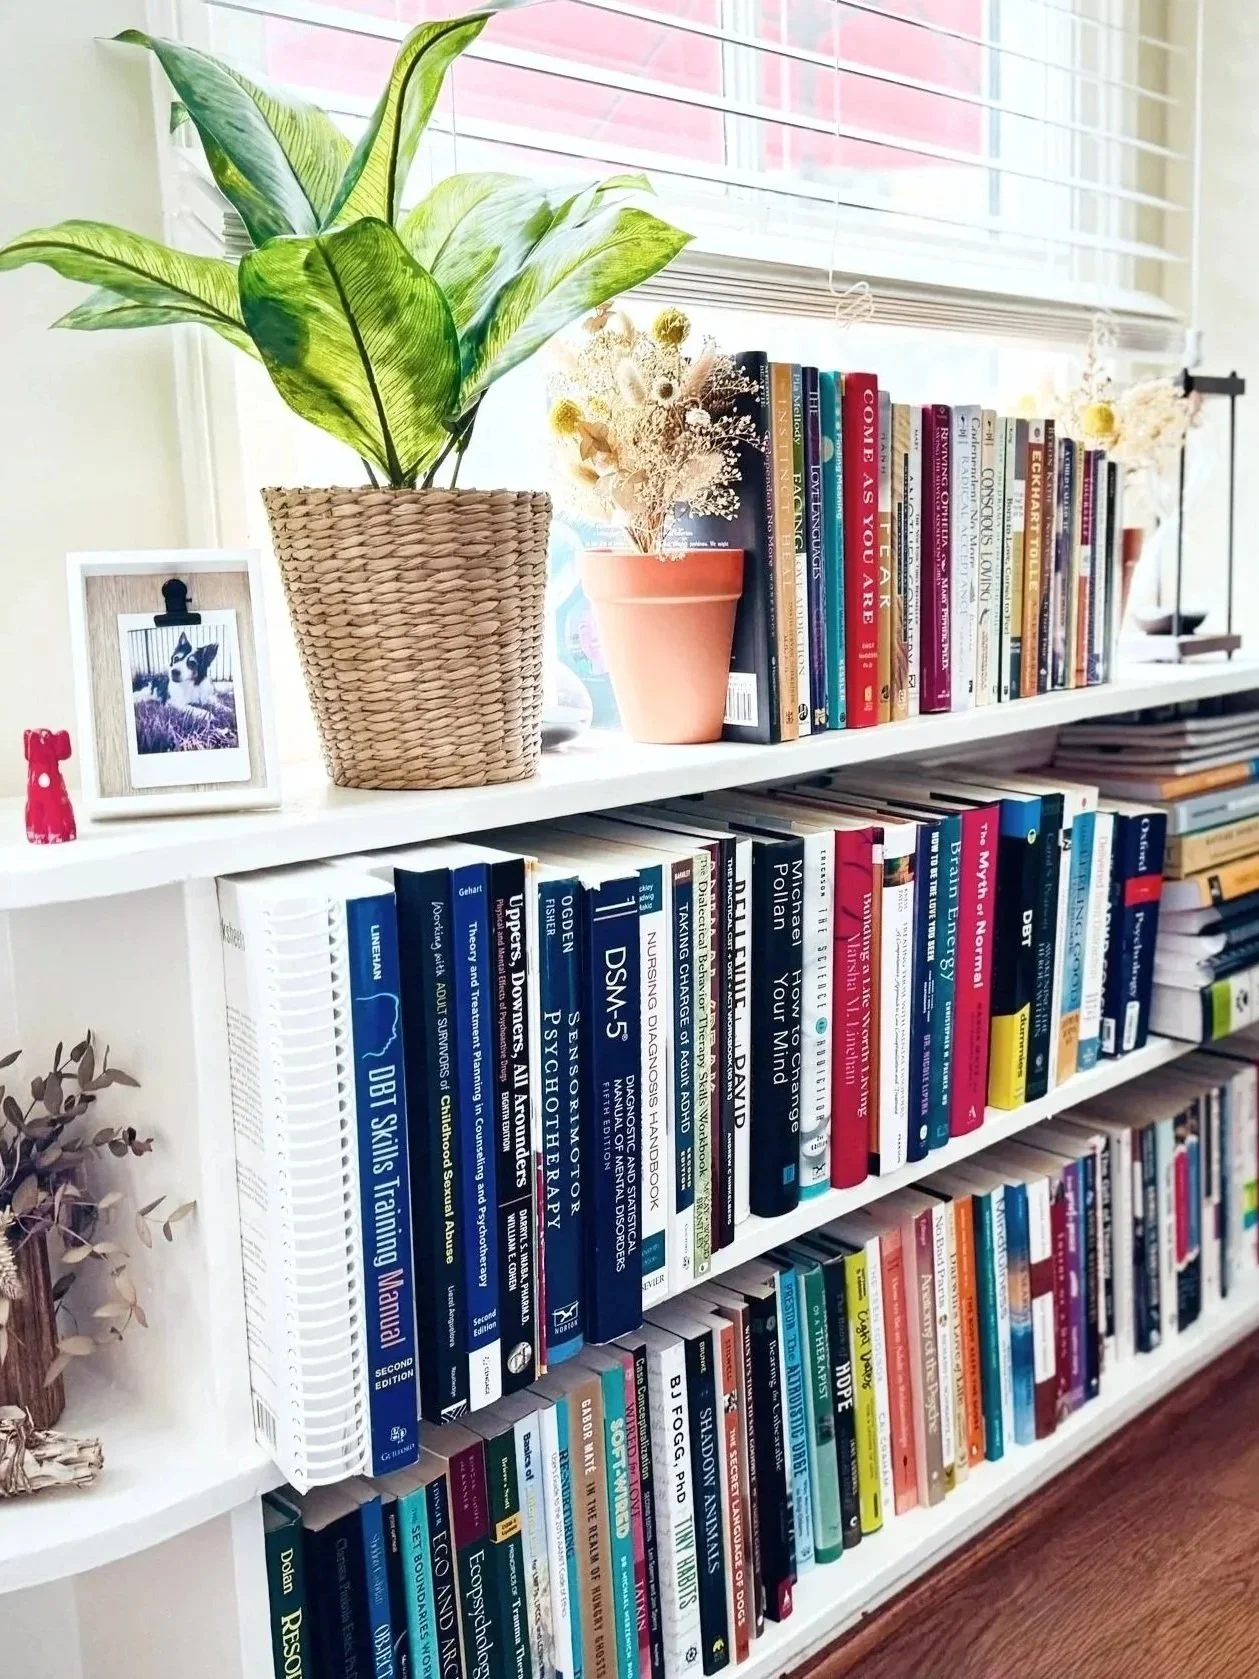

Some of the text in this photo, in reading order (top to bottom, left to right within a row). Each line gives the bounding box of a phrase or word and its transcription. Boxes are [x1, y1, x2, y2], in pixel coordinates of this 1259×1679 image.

[777, 399, 791, 514] INSTINCT
[809, 391, 822, 580] THE LOVE LANGUAGES
[941, 428, 949, 547] REVIVING OPHELIA
[793, 472, 803, 551] FACING
[863, 389, 874, 624] COME AS YOU ARE
[980, 468, 994, 601] CONSCIOUS LOVING
[1029, 451, 1042, 592] ECKHART TOLLE
[781, 533, 792, 592] HEAL
[879, 523, 892, 609] FEAR
[796, 598, 806, 676] ADDICTION
[975, 850, 990, 899] Myth
[979, 822, 988, 846] The
[1136, 817, 1151, 873] Oxford
[459, 887, 483, 897] Gehart
[545, 899, 556, 937] FISHER
[561, 895, 575, 954] OGDEN
[773, 862, 790, 931] Pollan
[791, 859, 803, 947] Michael
[939, 840, 962, 982] Brain Energy
[976, 903, 984, 916] of
[1021, 910, 1033, 948] DBT
[370, 925, 382, 980] LINEHAN
[973, 920, 987, 989] Normal
[1128, 911, 1145, 999] Psychology
[505, 893, 531, 1188] Uppers, Downers, All Arounders
[678, 902, 692, 1134] TAKING CHARGE of Adult ADHD
[695, 859, 710, 1178] The Dialectical Behavior Therapy Skills Workbook
[773, 973, 789, 1085] Your Mind
[857, 892, 872, 1118] Building a Life Worth Living
[1017, 1012, 1029, 1079] dummies
[431, 901, 456, 1265] Working with ADULT SURVIVORS of Childhood Sexual Abuse
[646, 932, 660, 1212] NURSING DIAGNOSIS HANDBOOK
[734, 1055, 747, 1130] DAVID
[788, 969, 802, 1134] How to Change
[466, 922, 490, 1288] Theory and Treatment Planning in Counseling and Psychotherapy
[502, 1092, 511, 1153] EIGHTH EDITION
[543, 1009, 562, 1230] PSYCHOTHERAPY
[567, 1011, 581, 1217] SENSORIMOTOR
[368, 1064, 406, 1350] DBT Skills Training Manual
[613, 1079, 626, 1273] MANUAL OF MENTAL DISORDERS
[625, 1075, 637, 1256] DIAGNOSTIC AND STATISTICAL
[934, 1216, 948, 1308] No Bad Parts
[994, 1198, 1008, 1320] Mindfulness
[554, 1320, 579, 1335] NORTON
[782, 1283, 795, 1331] PRESTON
[786, 1335, 798, 1360] The
[952, 1323, 963, 1364] Love
[375, 1358, 414, 1378] SECOND
[375, 1371, 415, 1392] EDITION
[766, 1339, 778, 1388] Bearing
[834, 1361, 853, 1414] HOPE
[919, 1273, 940, 1435] Anatomy of the Psyche
[956, 1375, 966, 1406] Life
[581, 1399, 597, 1476] GABOR MATÉ
[635, 1358, 651, 1480] Case Conceptualization
[669, 1375, 686, 1504] BJ FOGG, PhD
[770, 1403, 783, 1471] Unbearable
[786, 1364, 804, 1439] ALTRUISTIC
[559, 1448, 575, 1558] RE-NURTURING
[610, 1418, 631, 1540] SOFT-WIRED
[625, 1403, 642, 1520] WIRED for LOVE
[699, 1407, 720, 1574] SHADOW ANIMALS
[791, 1442, 809, 1477] URGE
[280, 1547, 295, 1595] Dolan
[675, 1515, 698, 1611] TINY HABITS
[729, 1428, 746, 1627] THE SECRET LANGUAGE OF DOGS
[431, 1530, 455, 1631] EGO AND
[585, 1482, 607, 1679] IN THE REALM OF HUNGRY GHOSTS
[635, 1580, 648, 1632] TATKIN
